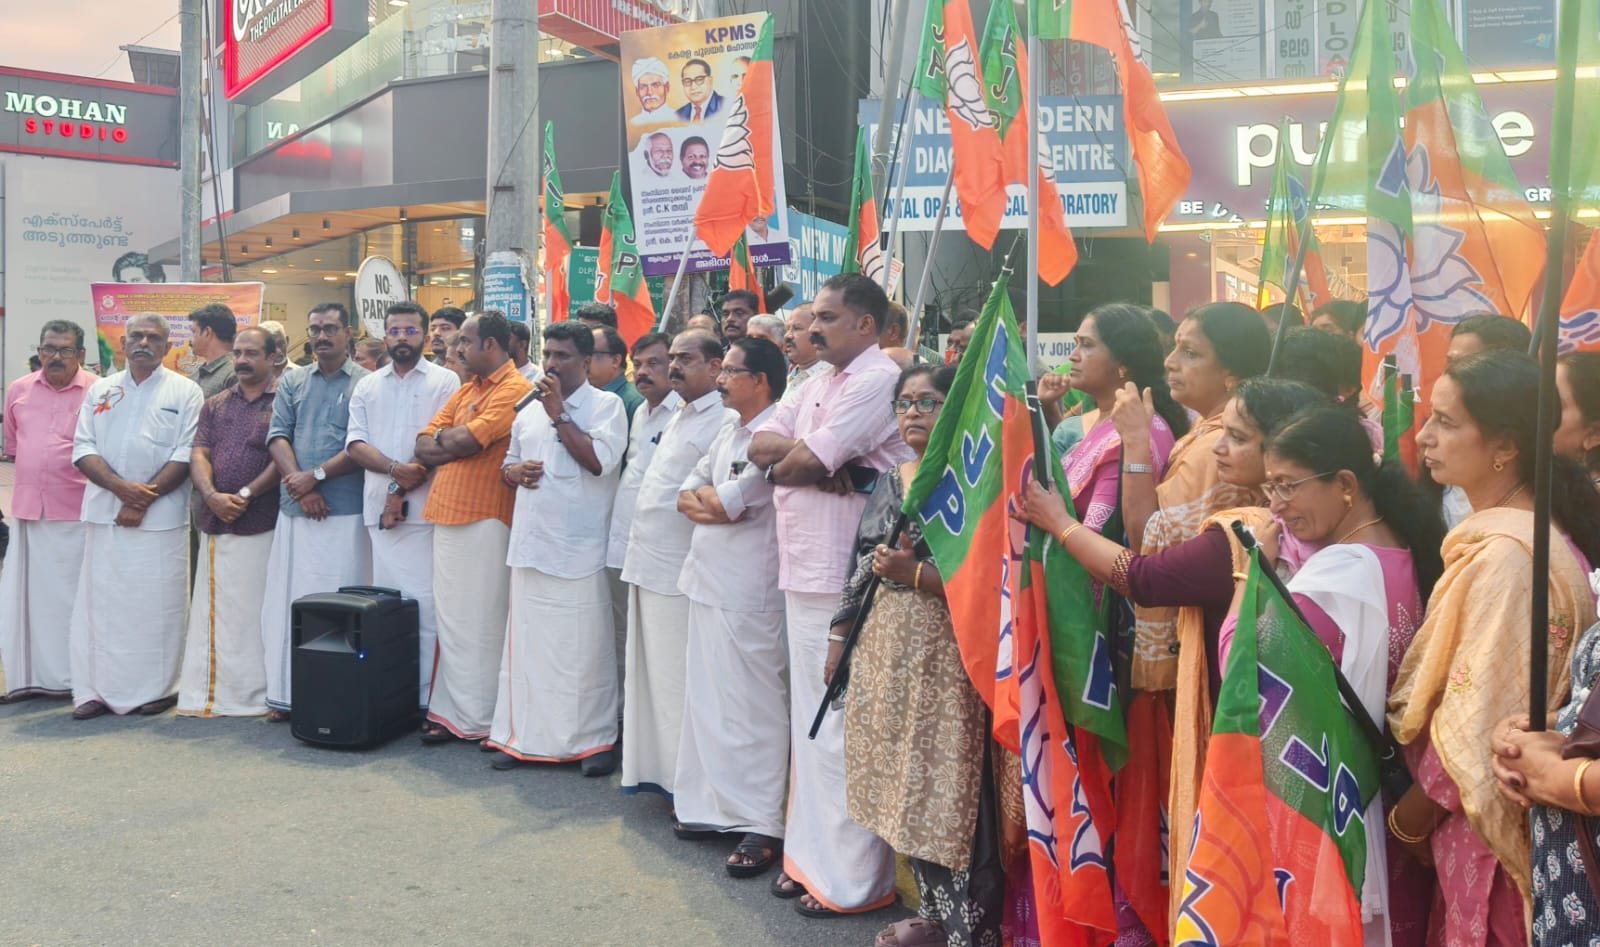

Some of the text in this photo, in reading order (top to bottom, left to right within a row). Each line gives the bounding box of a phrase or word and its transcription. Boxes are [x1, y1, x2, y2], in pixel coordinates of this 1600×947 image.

[705, 23, 756, 44] KPMS
[5, 91, 127, 124] MOHAN
[25, 117, 128, 143] STUDIO
[914, 104, 1115, 135] NE DERN
[1053, 144, 1115, 171] ENTRE
[656, 204, 669, 213] C.K
[1062, 192, 1118, 217] ORATORY
[1179, 201, 1203, 214] BE
[22, 211, 123, 233] എക്സ്പേർട്ട്
[22, 230, 134, 249] അടുത്തുണ്ട്
[801, 224, 830, 263] NEW
[375, 273, 391, 295] NO
